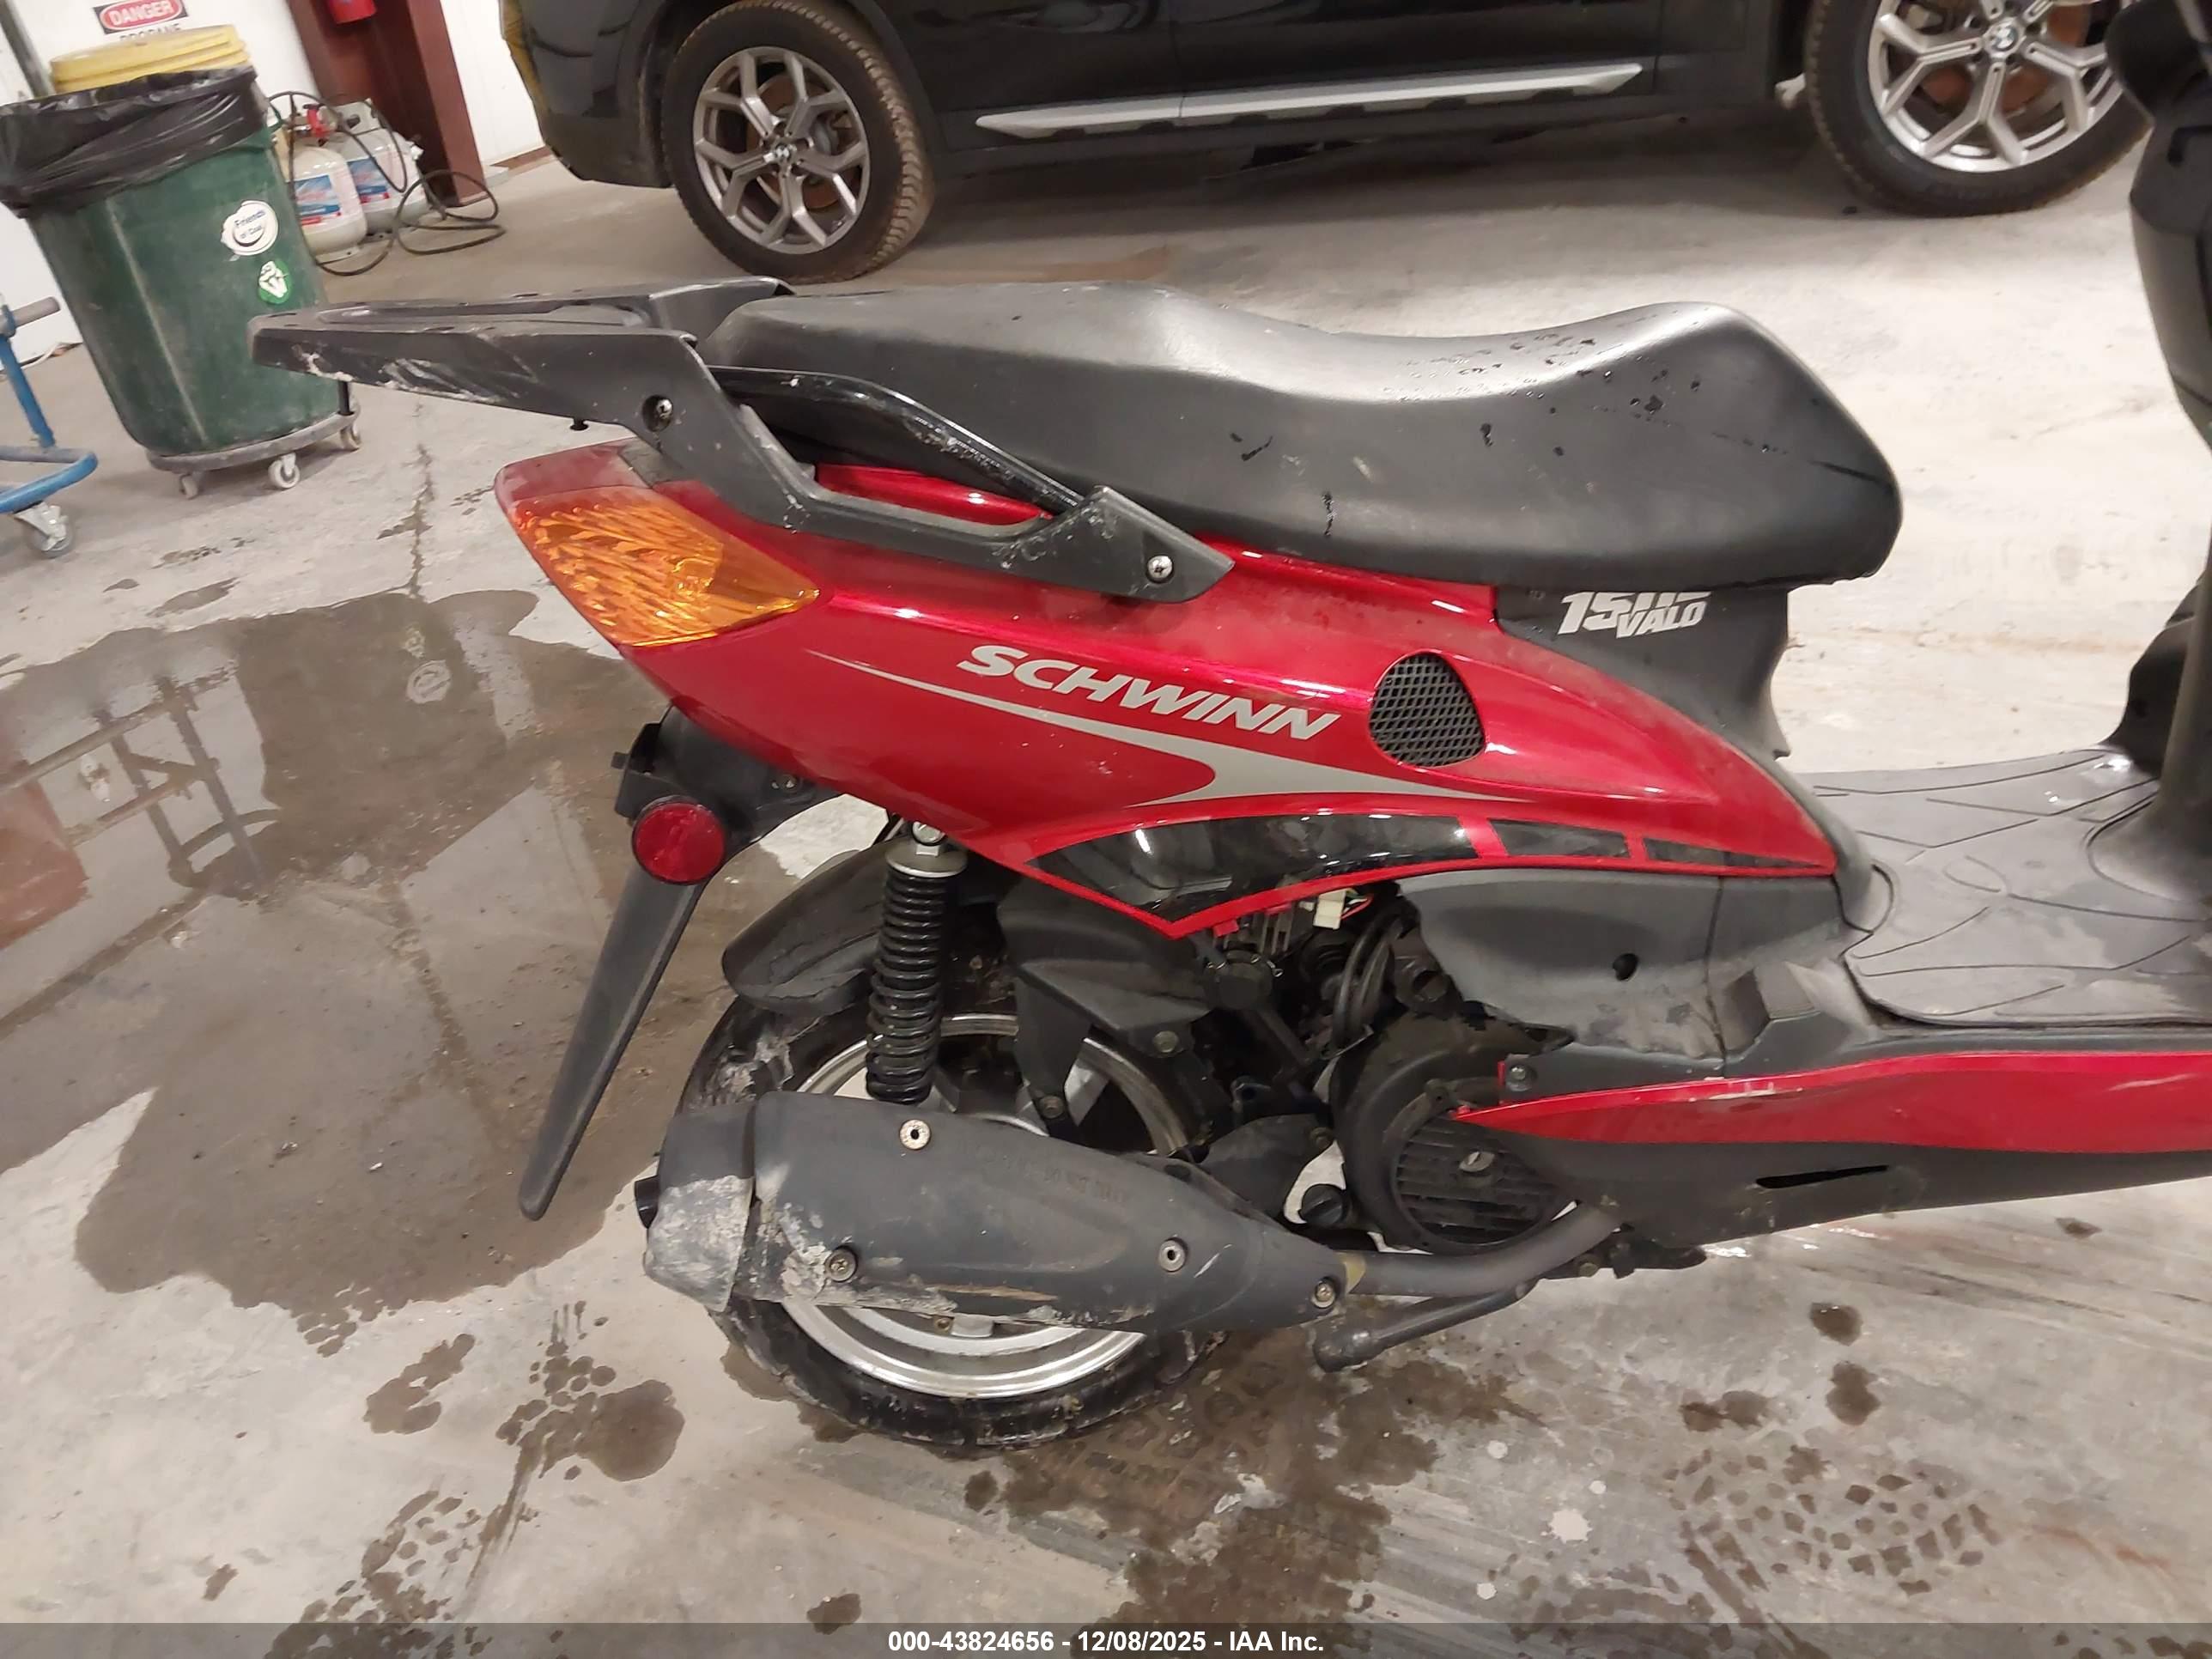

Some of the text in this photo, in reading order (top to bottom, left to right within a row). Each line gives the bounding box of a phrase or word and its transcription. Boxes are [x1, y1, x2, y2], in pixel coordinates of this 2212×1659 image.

[108, 1, 175, 26] DANGER
[1616, 601, 1708, 638] VALO
[957, 645, 1340, 740] SCHWINN
